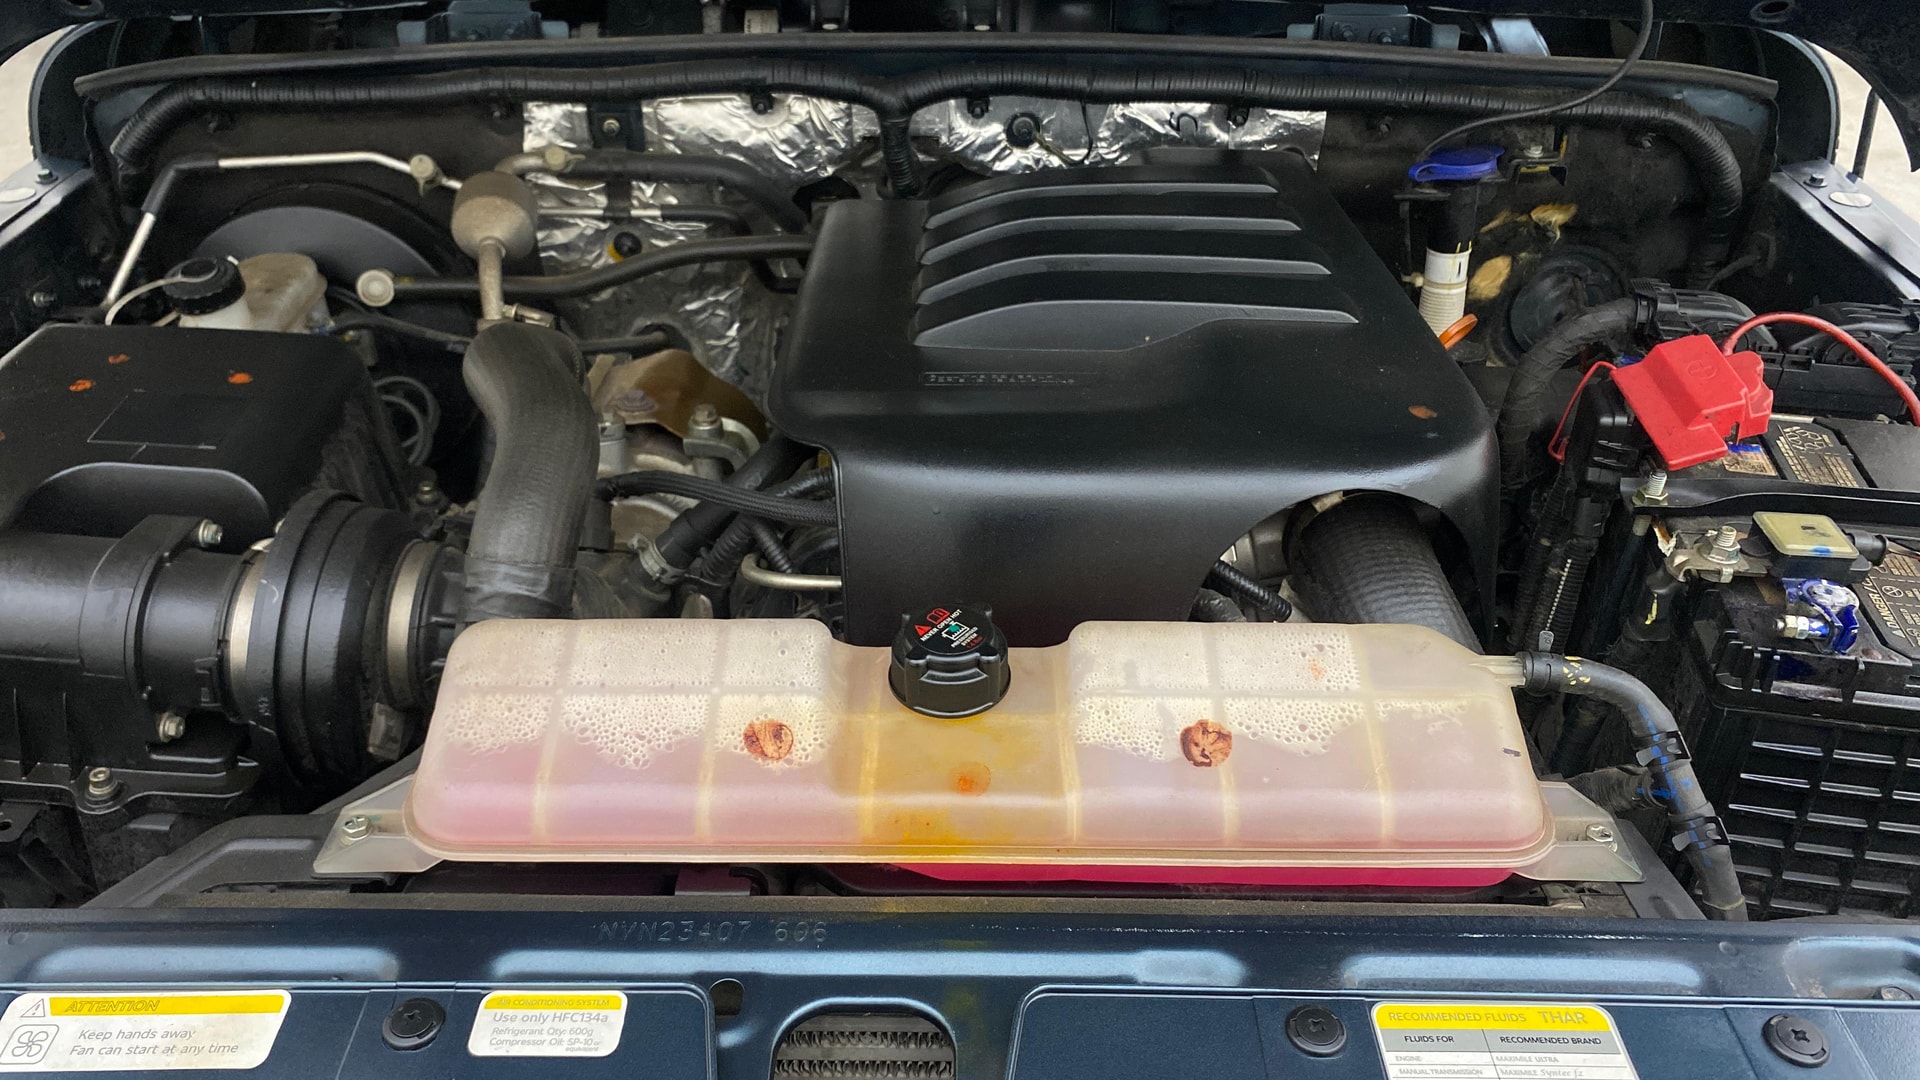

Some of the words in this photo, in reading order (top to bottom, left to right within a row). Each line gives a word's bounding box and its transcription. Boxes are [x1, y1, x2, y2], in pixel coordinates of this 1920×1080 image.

[1868, 593, 1900, 628] DANGER
[920, 627, 939, 641] NEVER
[937, 616, 952, 629] OPEN
[65, 999, 160, 1013] ATTENTION
[493, 1012, 518, 1023] Use
[521, 1012, 549, 1024] only
[551, 1012, 609, 1023] HFC134a
[1389, 1012, 1481, 1022] RECOMMENDED
[1486, 1013, 1527, 1023] FLUIDS
[1538, 1011, 1588, 1025] THAR
[78, 1029, 112, 1041] Keep
[117, 1028, 157, 1040] hands
[161, 1030, 196, 1041] away
[491, 1027, 544, 1037] Refrigerant
[569, 1028, 594, 1037] 600g
[489, 1037, 546, 1048] Compressor
[567, 1038, 593, 1046] SP-10
[1404, 1035, 1434, 1043] FLUIDS
[1499, 1036, 1569, 1045] RECOMMENDED
[1571, 1037, 1602, 1046] BRAND
[69, 1045, 94, 1056] Fan
[98, 1047, 122, 1056] can
[125, 1045, 159, 1055] start
[162, 1045, 177, 1055] at
[180, 1046, 206, 1056] any
[208, 1043, 239, 1054] time
